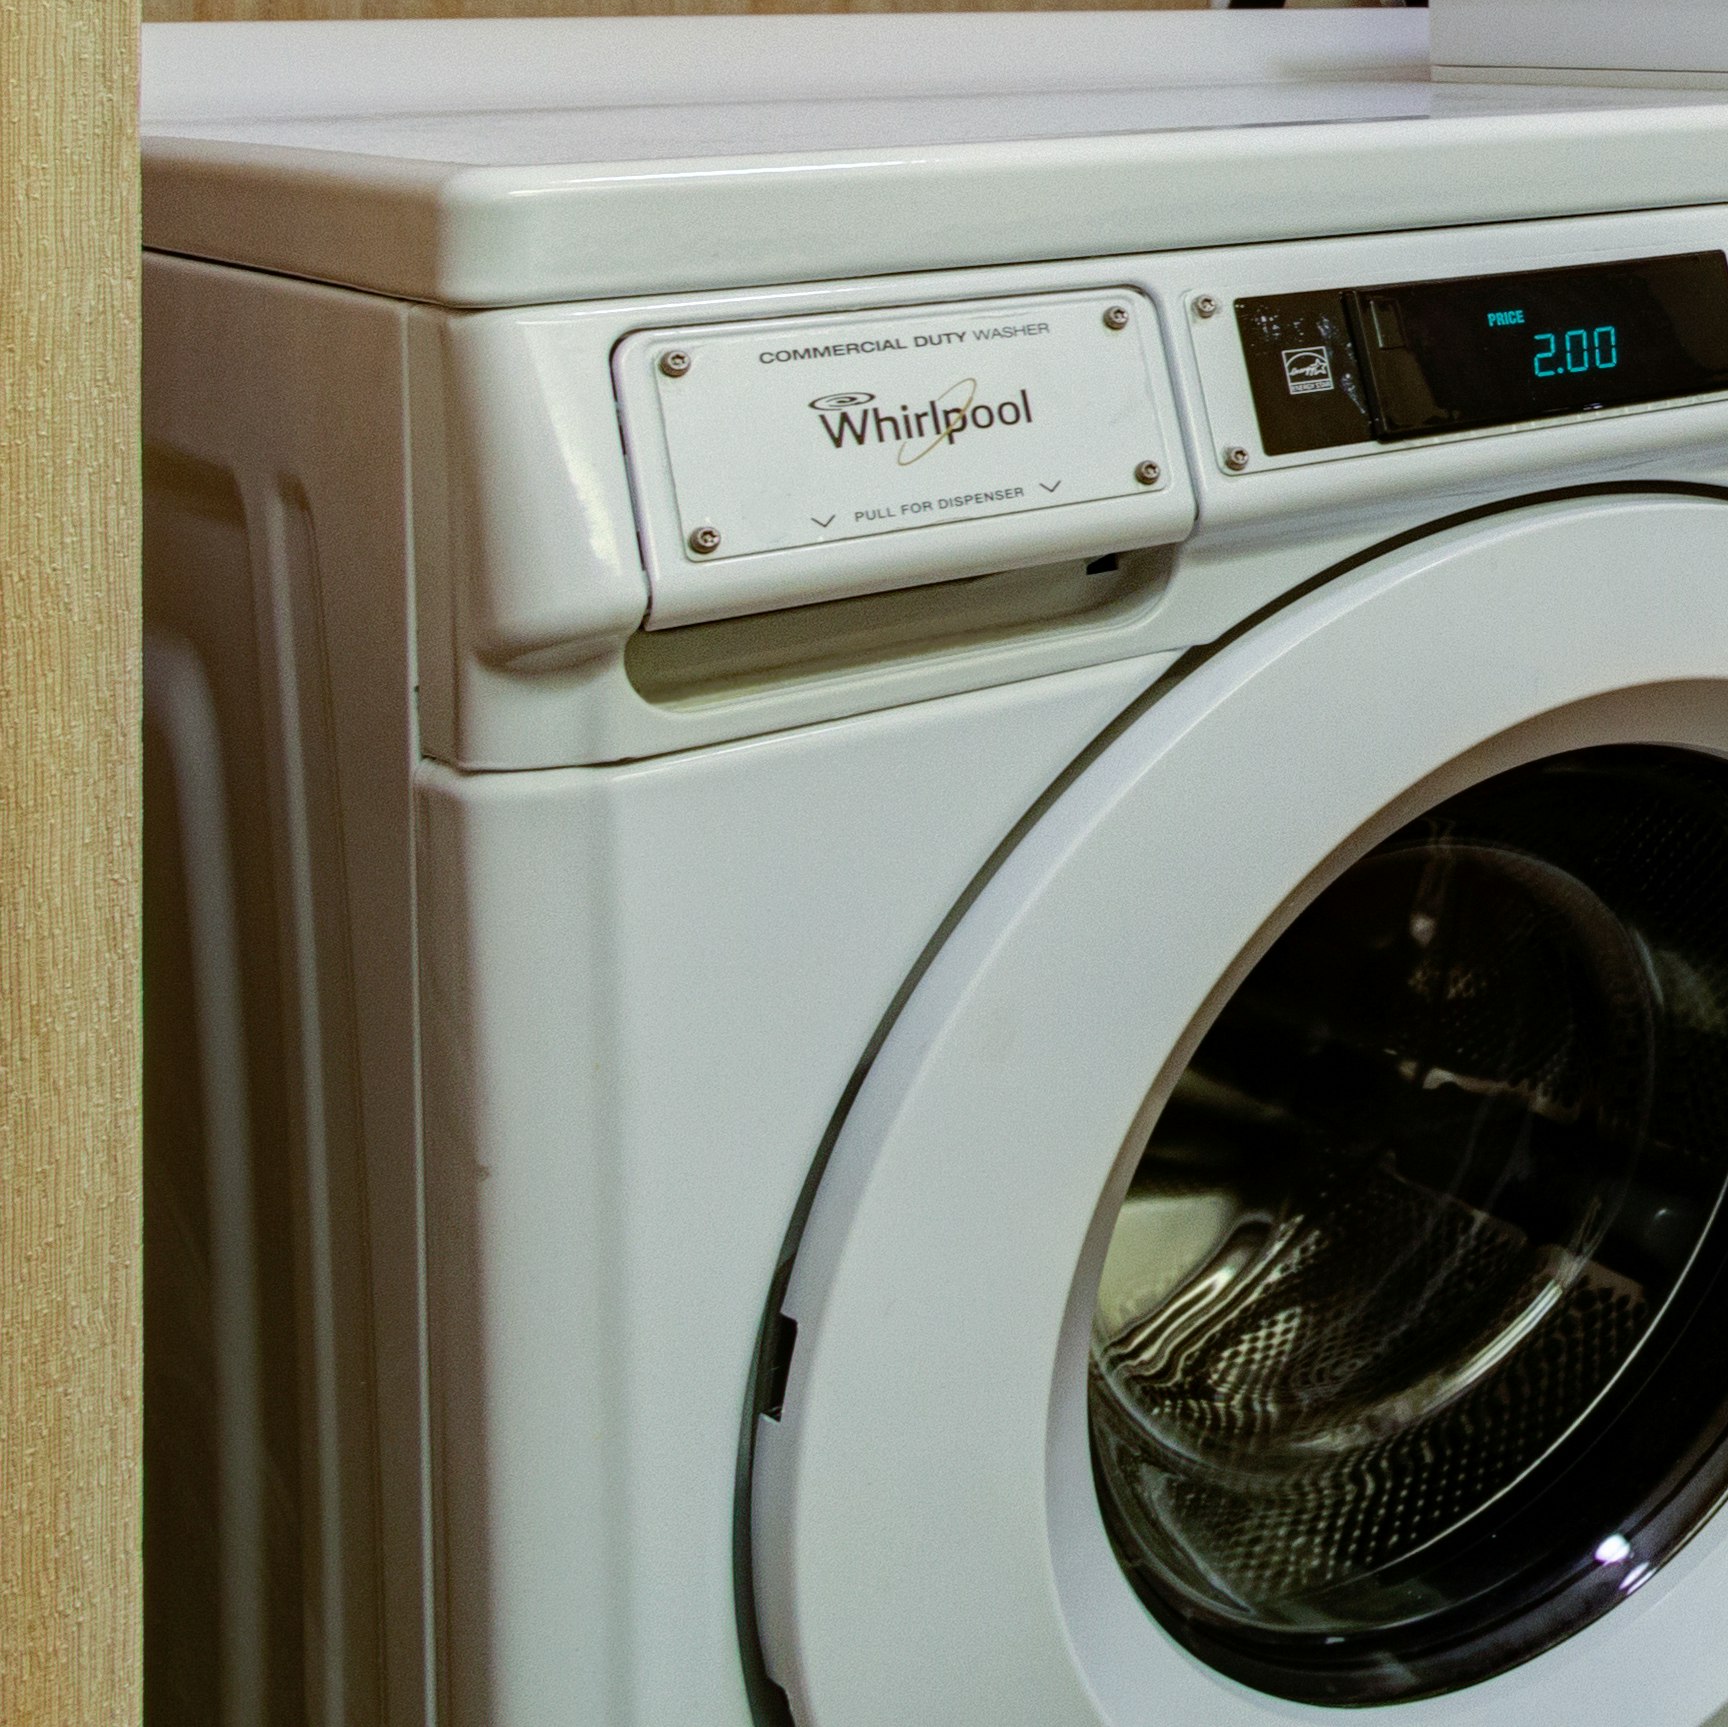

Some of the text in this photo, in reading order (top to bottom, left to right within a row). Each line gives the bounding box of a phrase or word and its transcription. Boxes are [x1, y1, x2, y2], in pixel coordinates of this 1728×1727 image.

[1487, 309, 1525, 327] PRICE
[759, 322, 1051, 364] COMMERCIAL DUTY WASHER
[1534, 326, 1617, 377] 2.00
[818, 389, 1034, 449] Whirlpool
[854, 486, 1025, 523] PULL FOR DISPENSER
